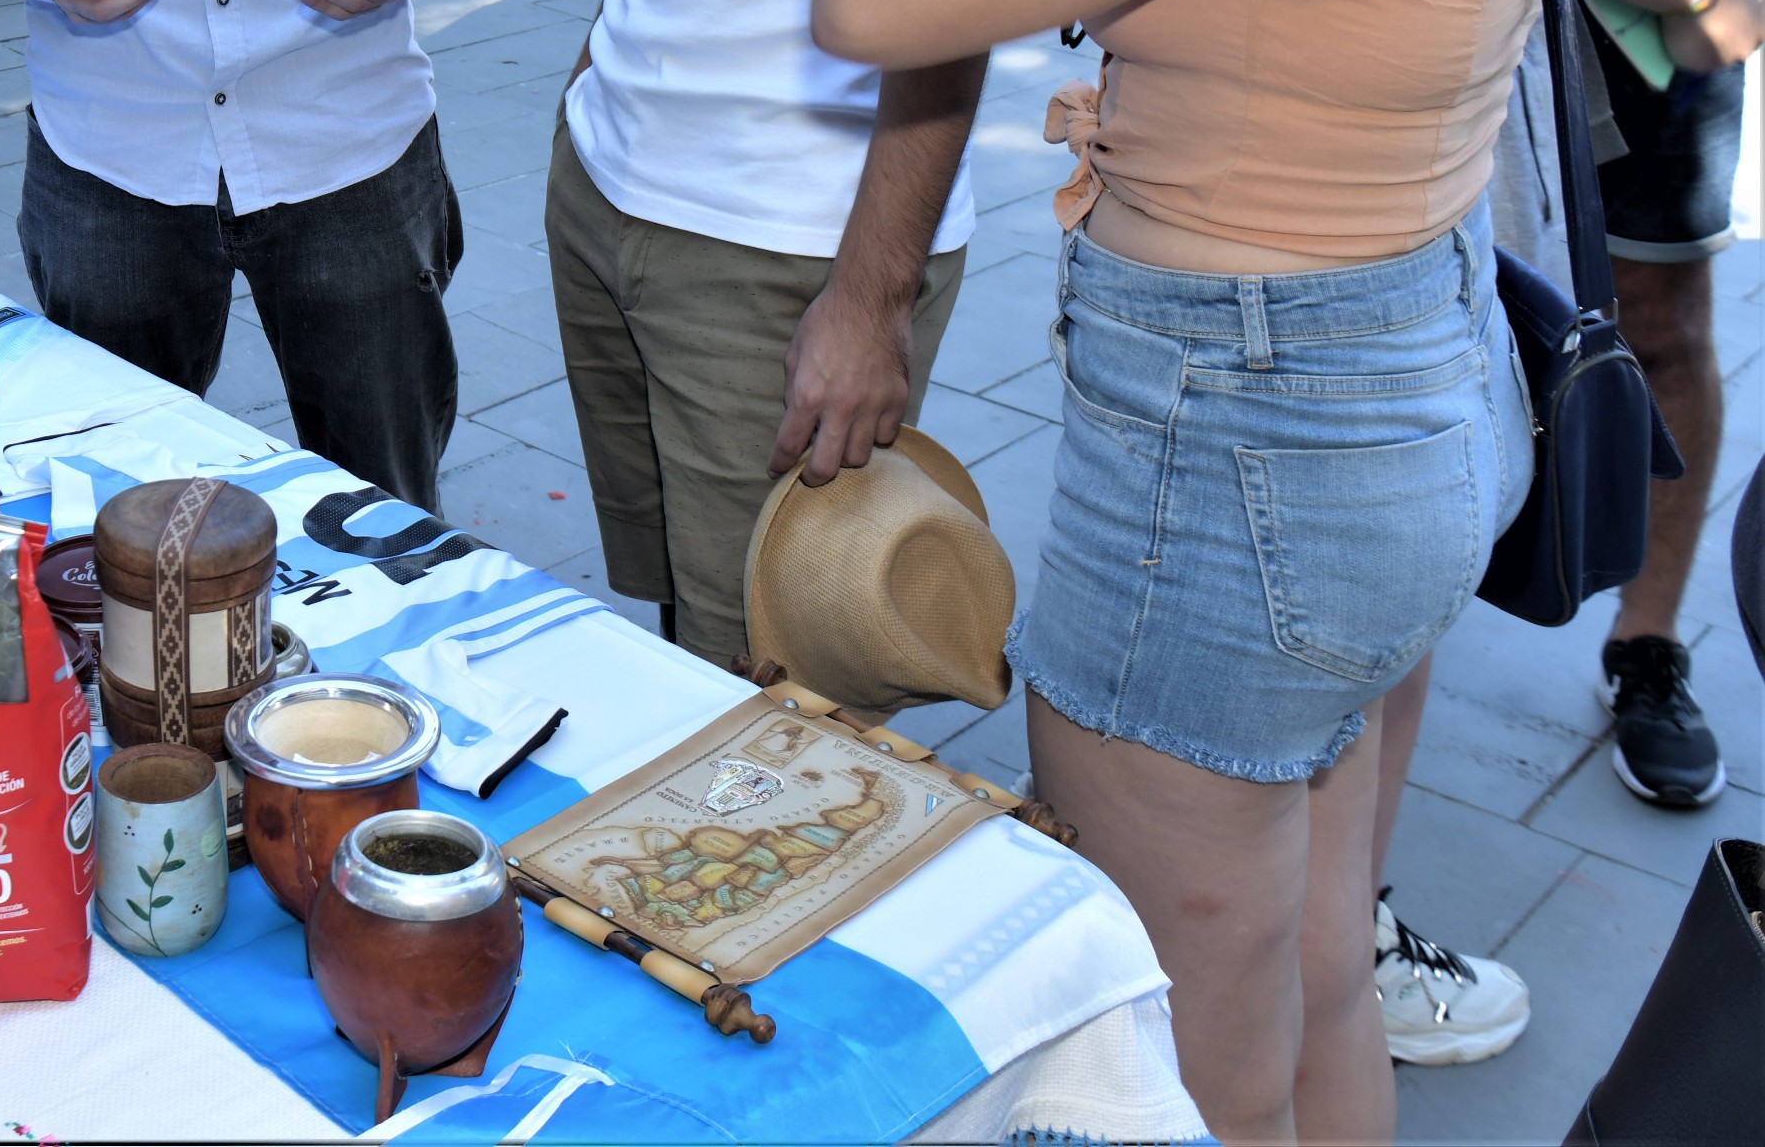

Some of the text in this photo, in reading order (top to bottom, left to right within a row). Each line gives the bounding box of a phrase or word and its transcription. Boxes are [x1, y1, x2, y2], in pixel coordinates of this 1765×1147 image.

[833, 739, 956, 799] ARGENTINA
[643, 797, 830, 826] OCEANO ATLANTICO
[655, 792, 697, 813] CAMINITO
[664, 787, 694, 804] LA BOCA
[839, 834, 905, 880] OCEANO
[737, 888, 826, 947] PACIFICO
